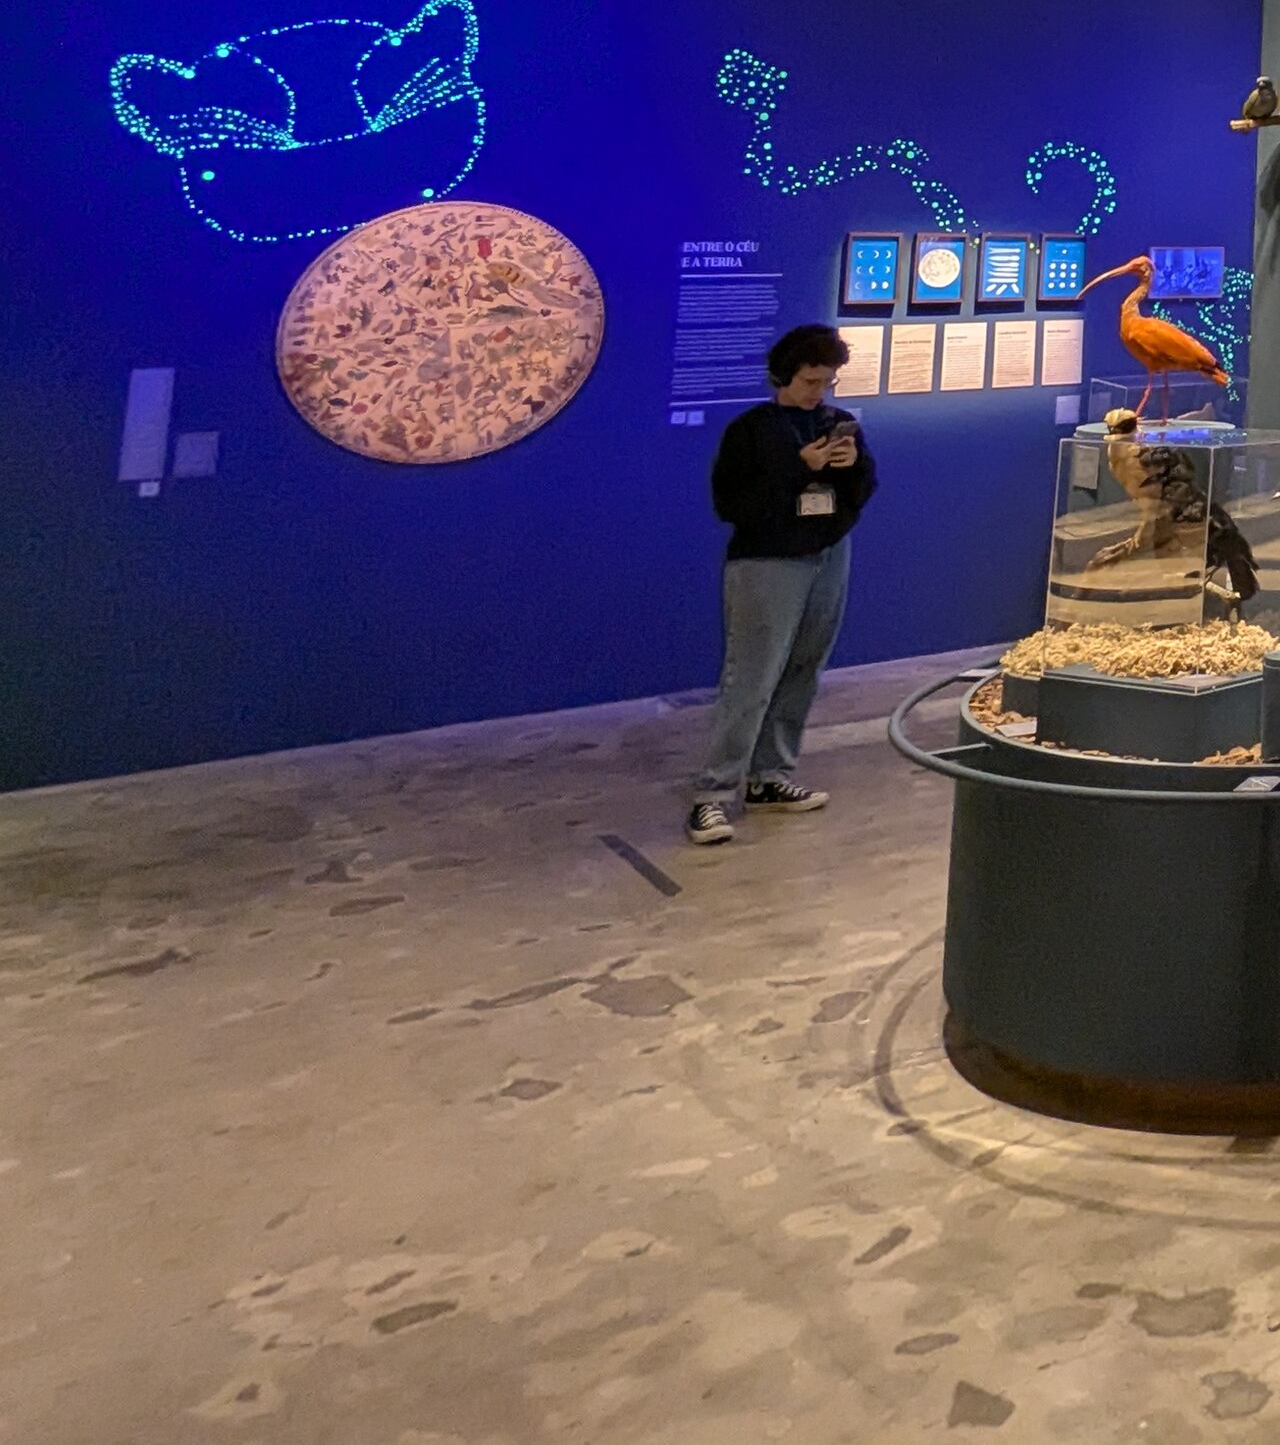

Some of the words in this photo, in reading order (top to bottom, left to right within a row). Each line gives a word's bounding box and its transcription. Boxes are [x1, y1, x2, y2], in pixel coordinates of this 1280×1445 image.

[683, 241, 724, 253] ENTRE
[725, 241, 734, 252] O
[736, 240, 760, 252] CÉU
[682, 257, 690, 268] E
[691, 257, 701, 267] A
[703, 257, 743, 267] TERRA
